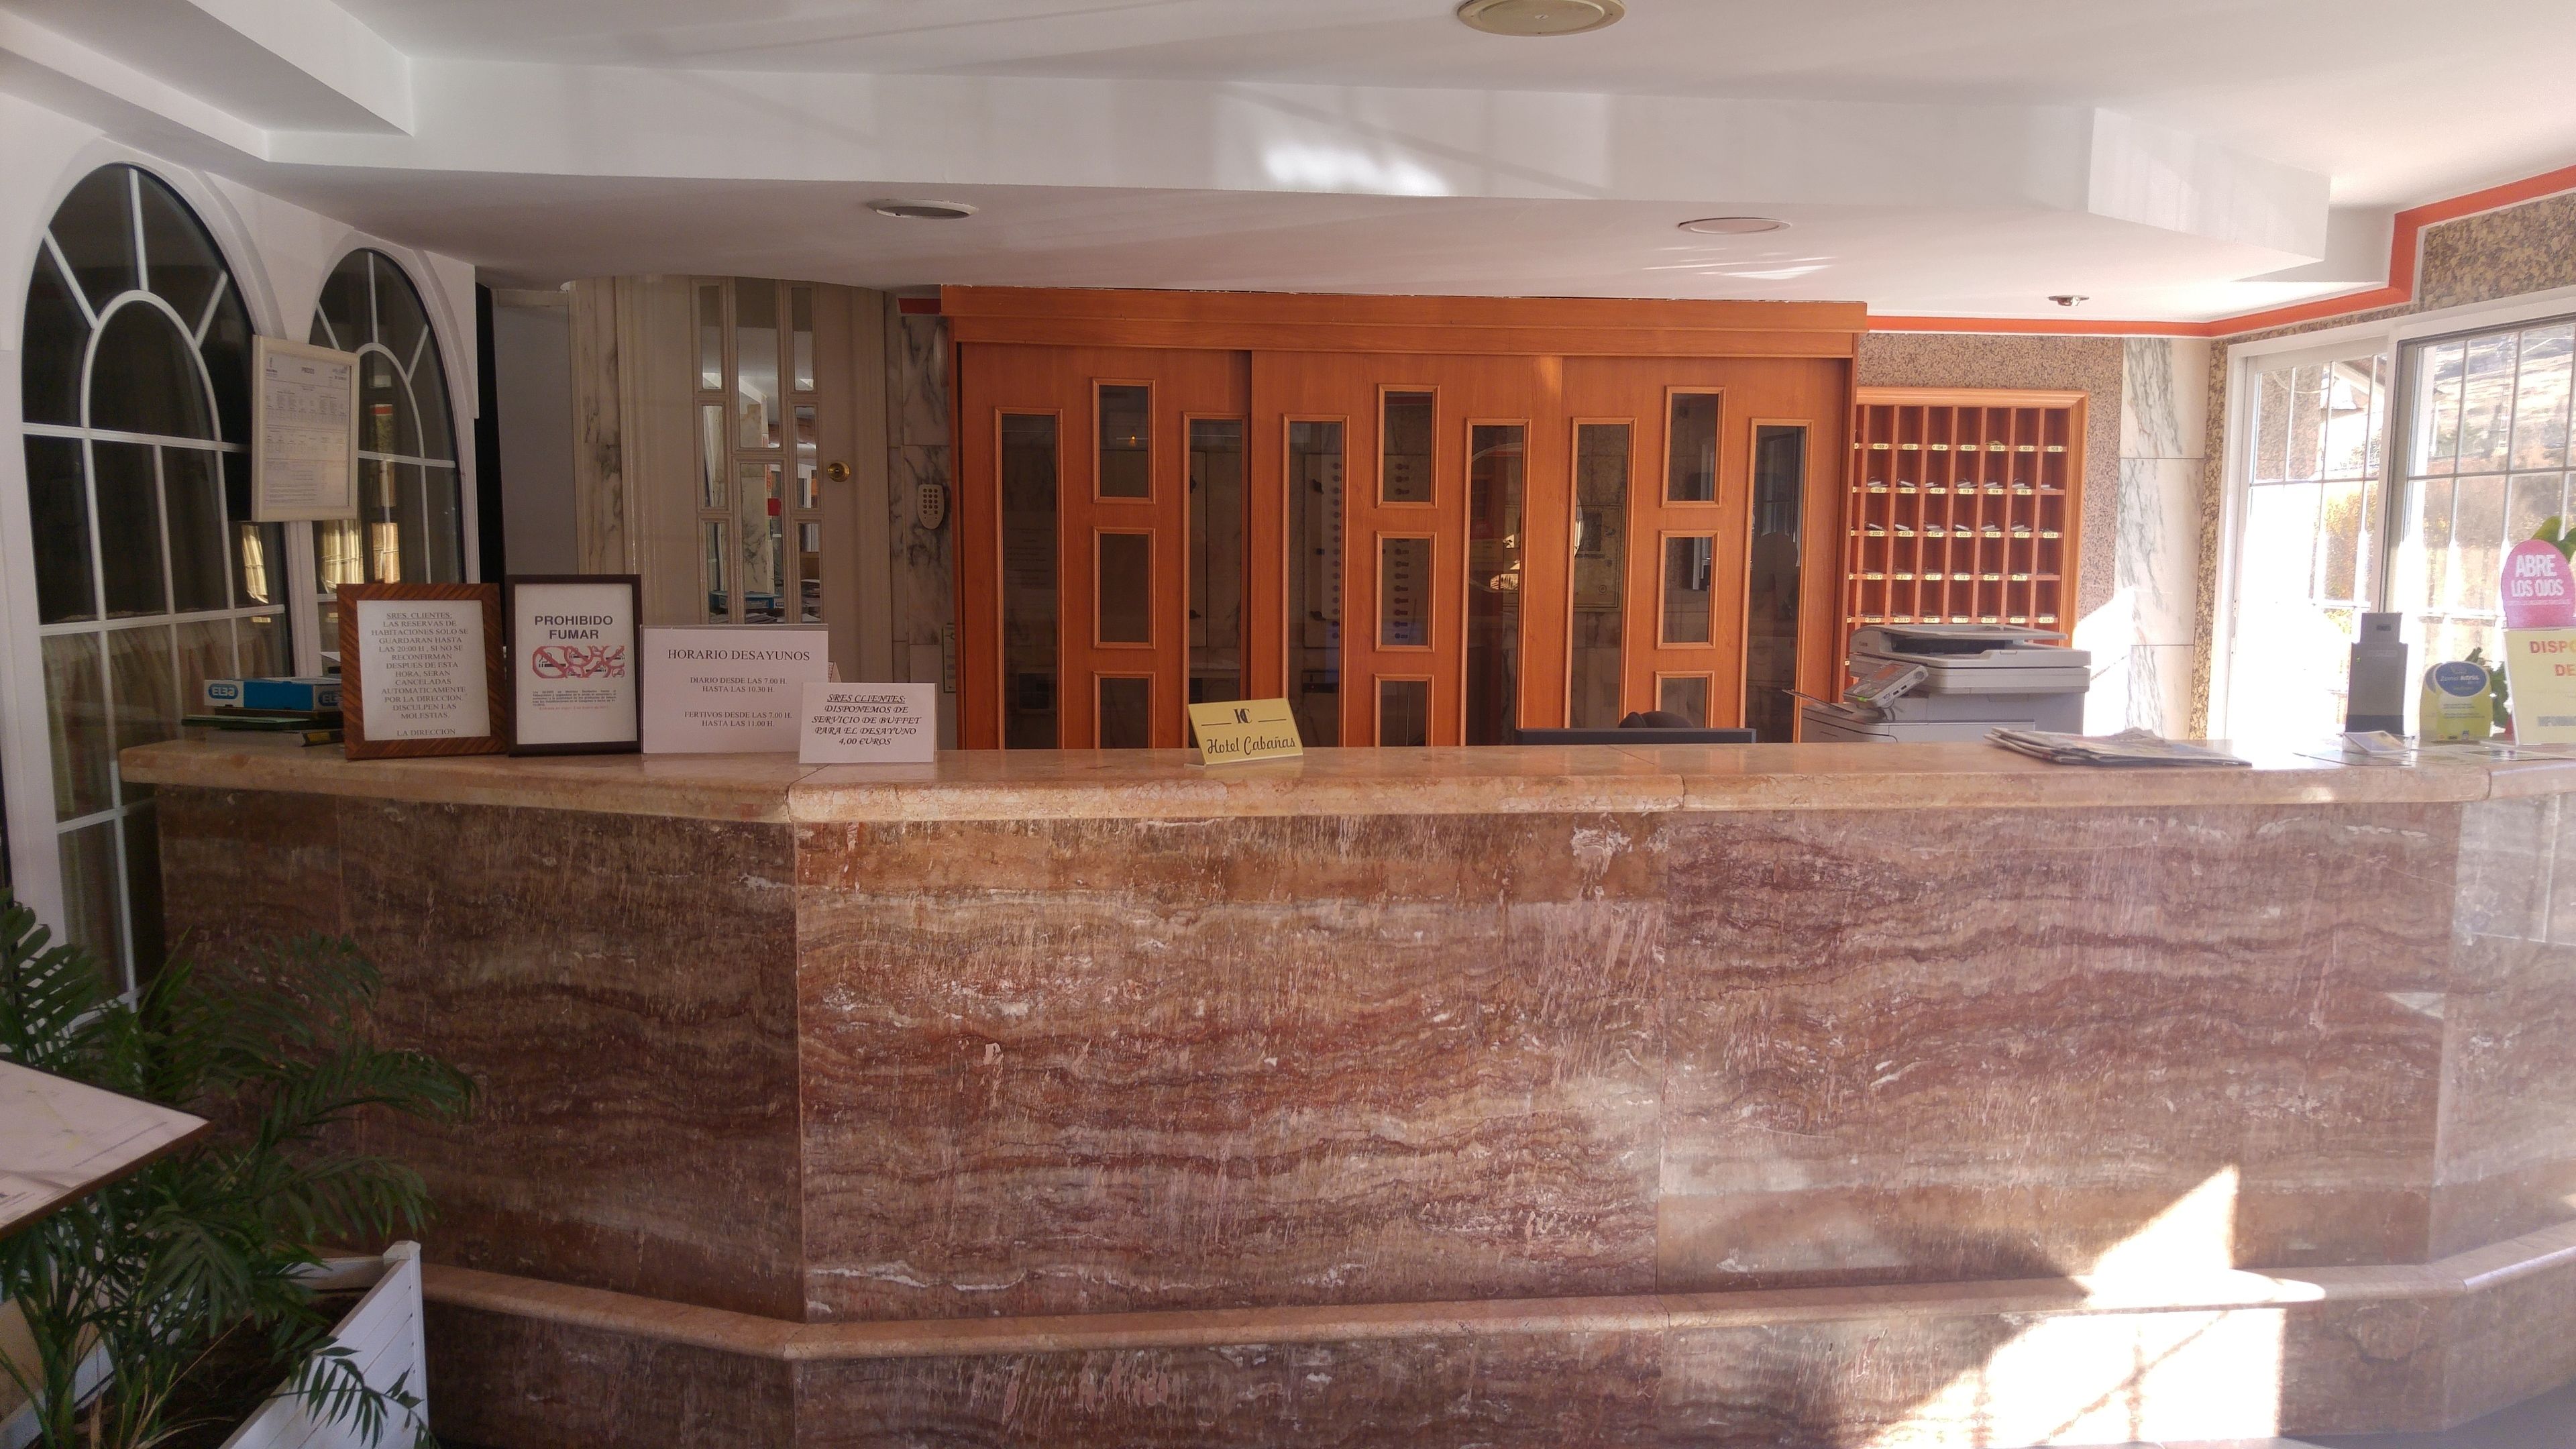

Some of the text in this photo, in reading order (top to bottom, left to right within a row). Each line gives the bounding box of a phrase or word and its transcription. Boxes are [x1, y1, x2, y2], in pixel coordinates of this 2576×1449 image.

[2516, 554, 2557, 577] ABRE
[2511, 579, 2565, 597] LOS OJOS
[535, 615, 613, 625] PROHIBIDO
[549, 629, 599, 639] FUMAR
[667, 649, 810, 661] HORARIO DESAYUNOS
[381, 686, 467, 694] AUTOMATICAMENTE
[827, 694, 906, 703] SRES CLIENTES:
[824, 705, 891, 713] DISPONEMOS
[811, 716, 860, 724] SERVICIO
[879, 716, 922, 724] BUFFET
[814, 727, 841, 735] PARA
[860, 727, 916, 735] DESAYUNO
[1207, 735, 1296, 755] Hotel Cabañas
